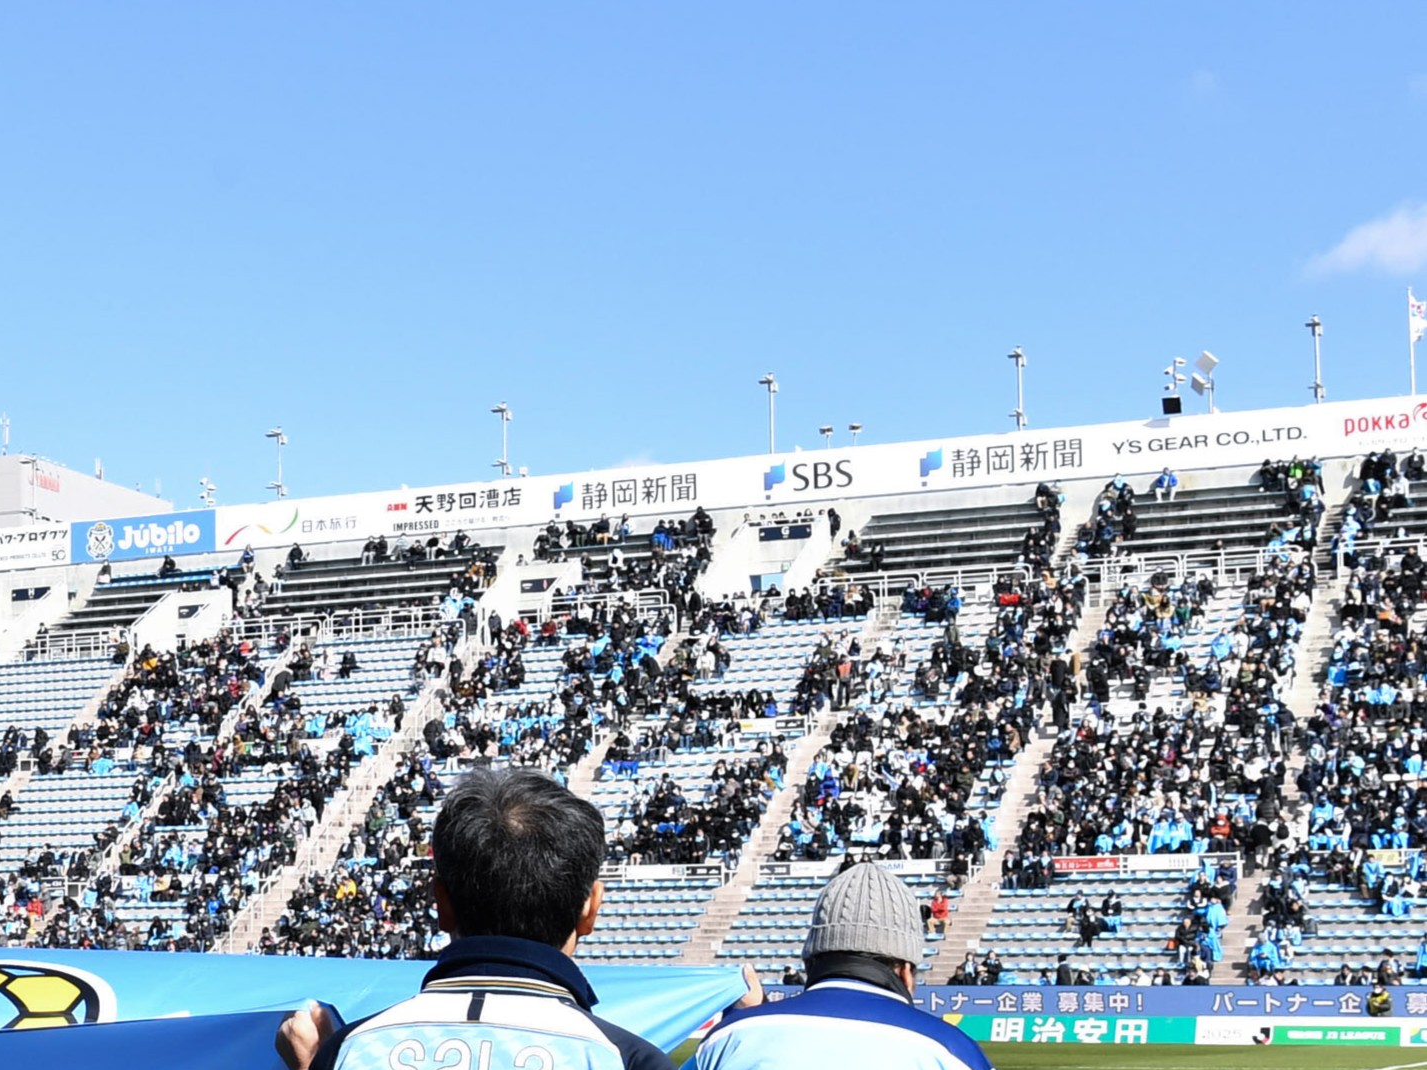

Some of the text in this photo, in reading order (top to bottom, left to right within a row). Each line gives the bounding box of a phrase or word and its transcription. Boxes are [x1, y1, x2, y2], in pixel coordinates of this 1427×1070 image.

[1113, 439, 1142, 455] Y'S
[1148, 434, 1209, 452] GEAR
[952, 438, 1083, 478] 静岡新聞
[792, 459, 853, 491] SBS
[415, 487, 522, 514] 天野回漕店
[581, 473, 698, 511] 静岡新聞
[301, 515, 358, 534] 日本旅行
[393, 520, 439, 532] IMPRESSED
[145, 546, 174, 555] IWATA
[914, 991, 1043, 1013] ートナー企業
[1212, 992, 1367, 1015] パートナー企
[991, 1016, 1149, 1044] 明治安田
